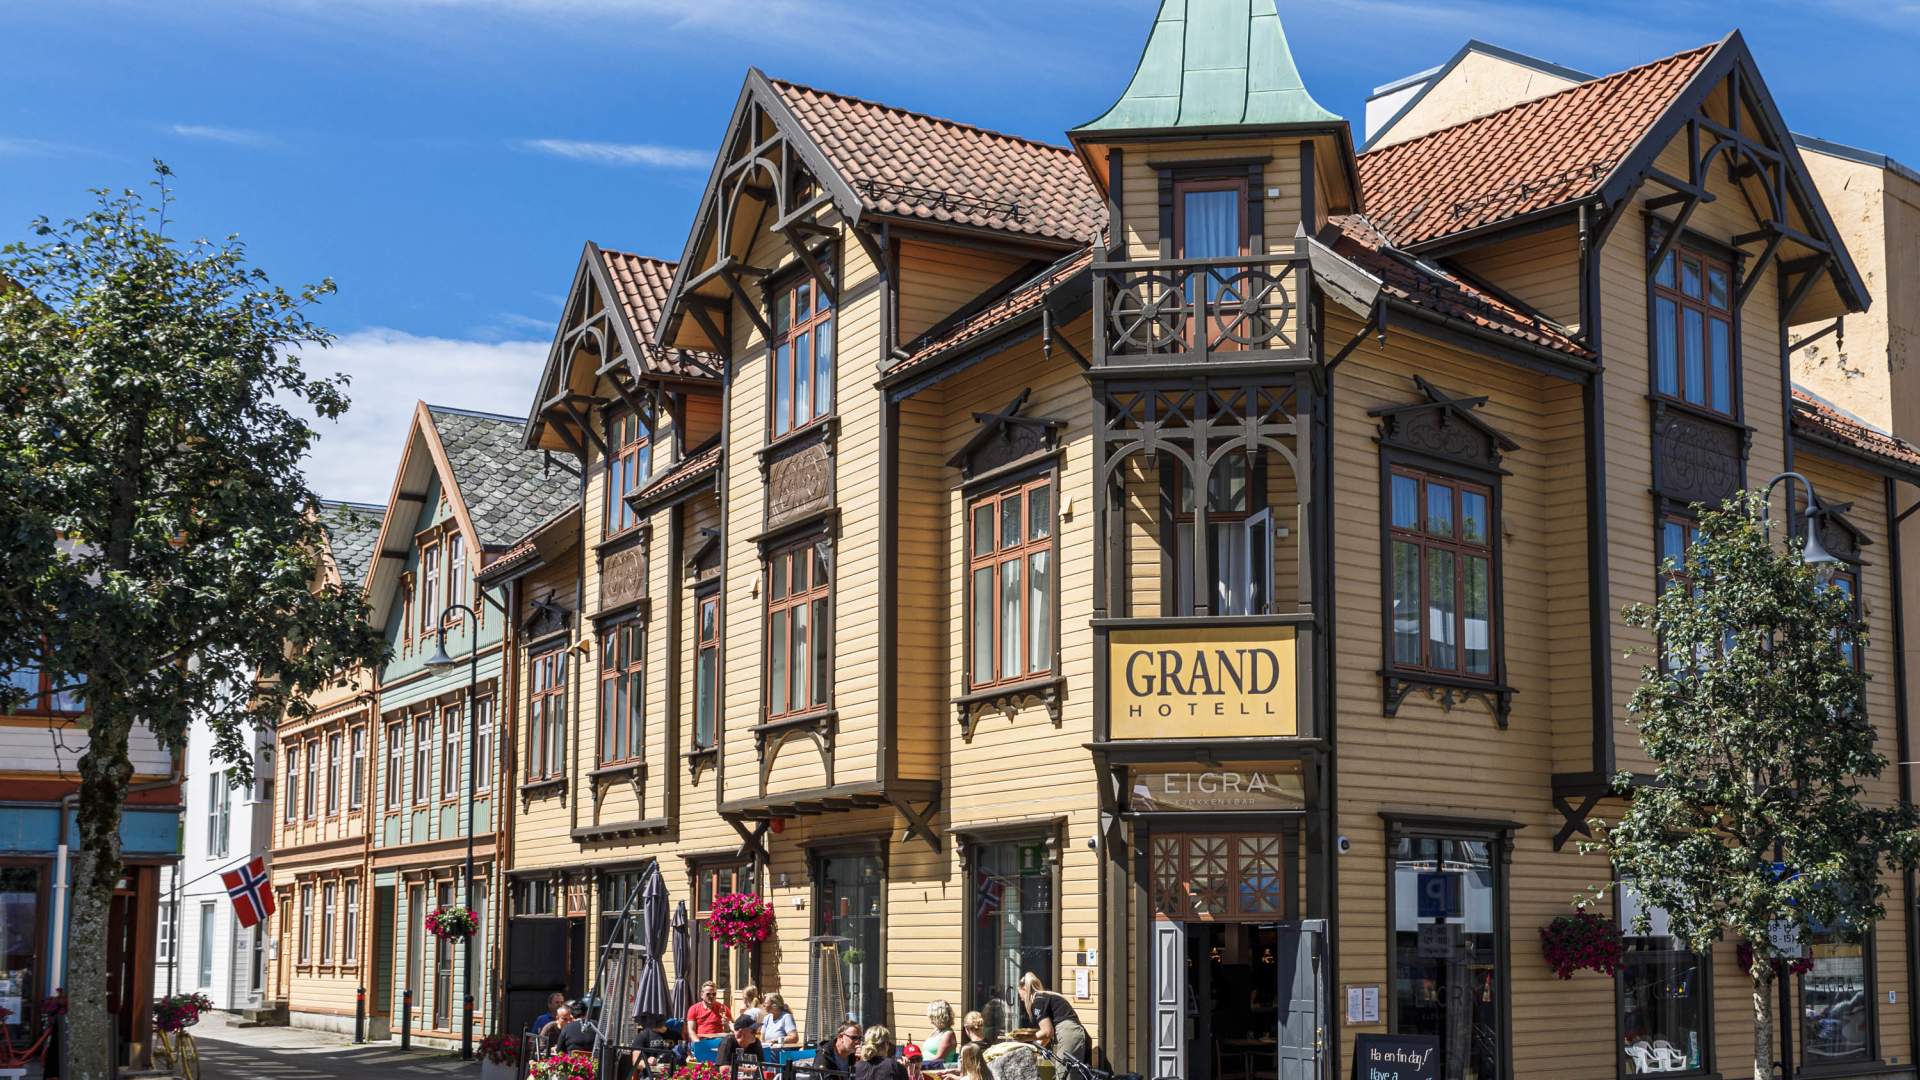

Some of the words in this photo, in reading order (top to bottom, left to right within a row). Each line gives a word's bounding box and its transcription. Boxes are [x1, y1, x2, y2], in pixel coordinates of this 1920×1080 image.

[1126, 648, 1280, 697] GRAND
[1129, 702, 1275, 717] HOTELL
[1164, 772, 1266, 794] EIGRA
[1370, 1048, 1381, 1061] Ha
[1384, 1052, 1395, 1062] en
[1397, 1047, 1407, 1063] fin
